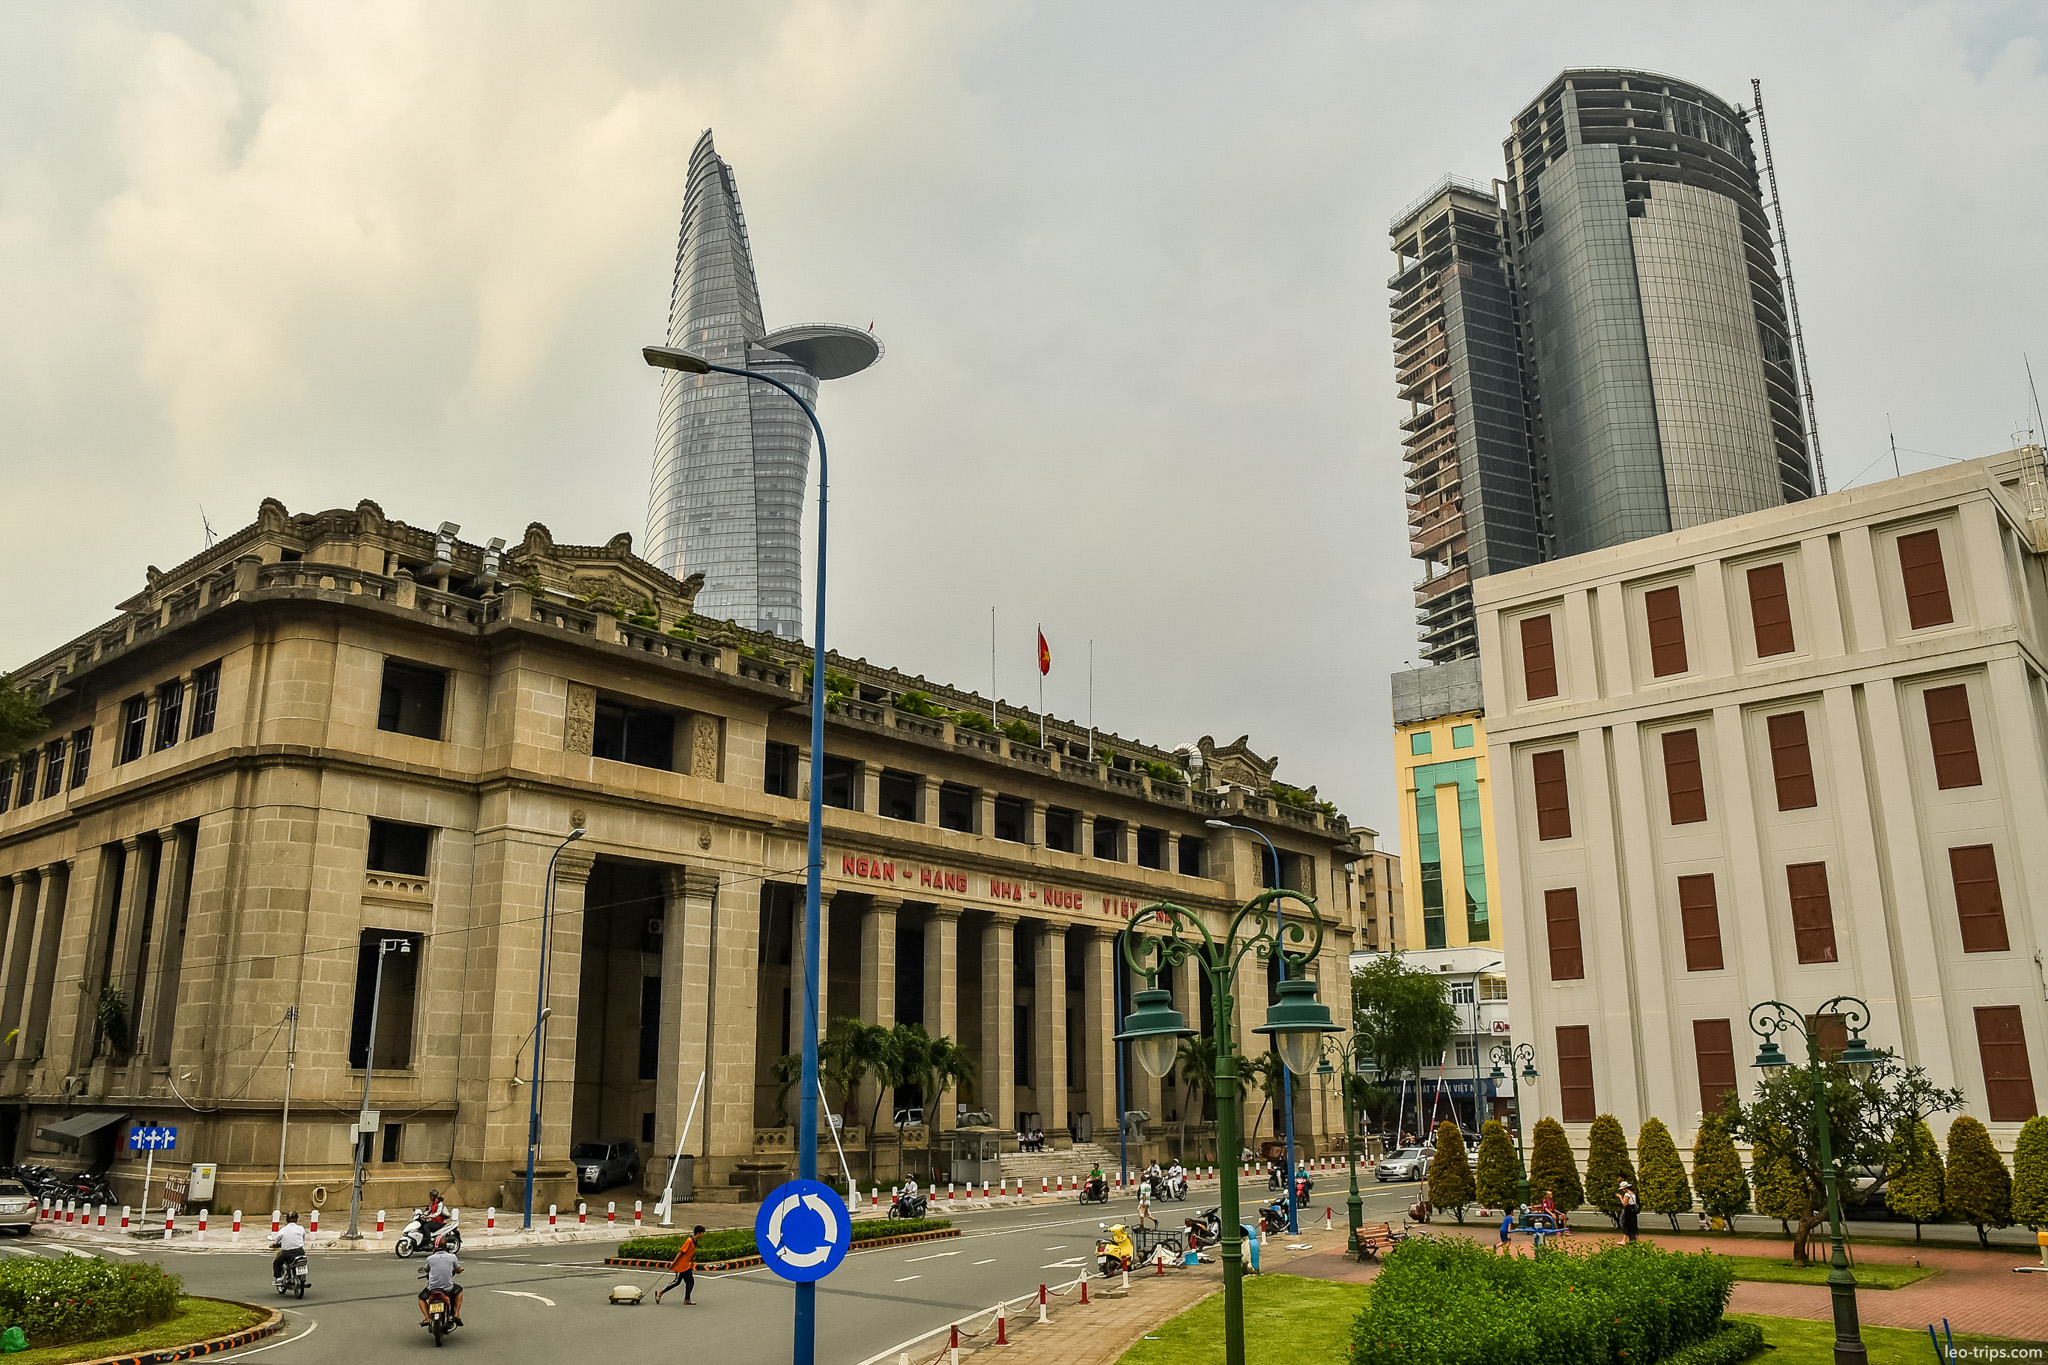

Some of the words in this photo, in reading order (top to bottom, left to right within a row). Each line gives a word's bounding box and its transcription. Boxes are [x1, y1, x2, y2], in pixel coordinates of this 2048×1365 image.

[843, 855, 895, 881] NGAN
[920, 868, 968, 892] HANG
[991, 879, 1022, 901] NHA
[1043, 887, 1083, 909] NUOC
[1453, 1082, 1468, 1095] VIỆT
